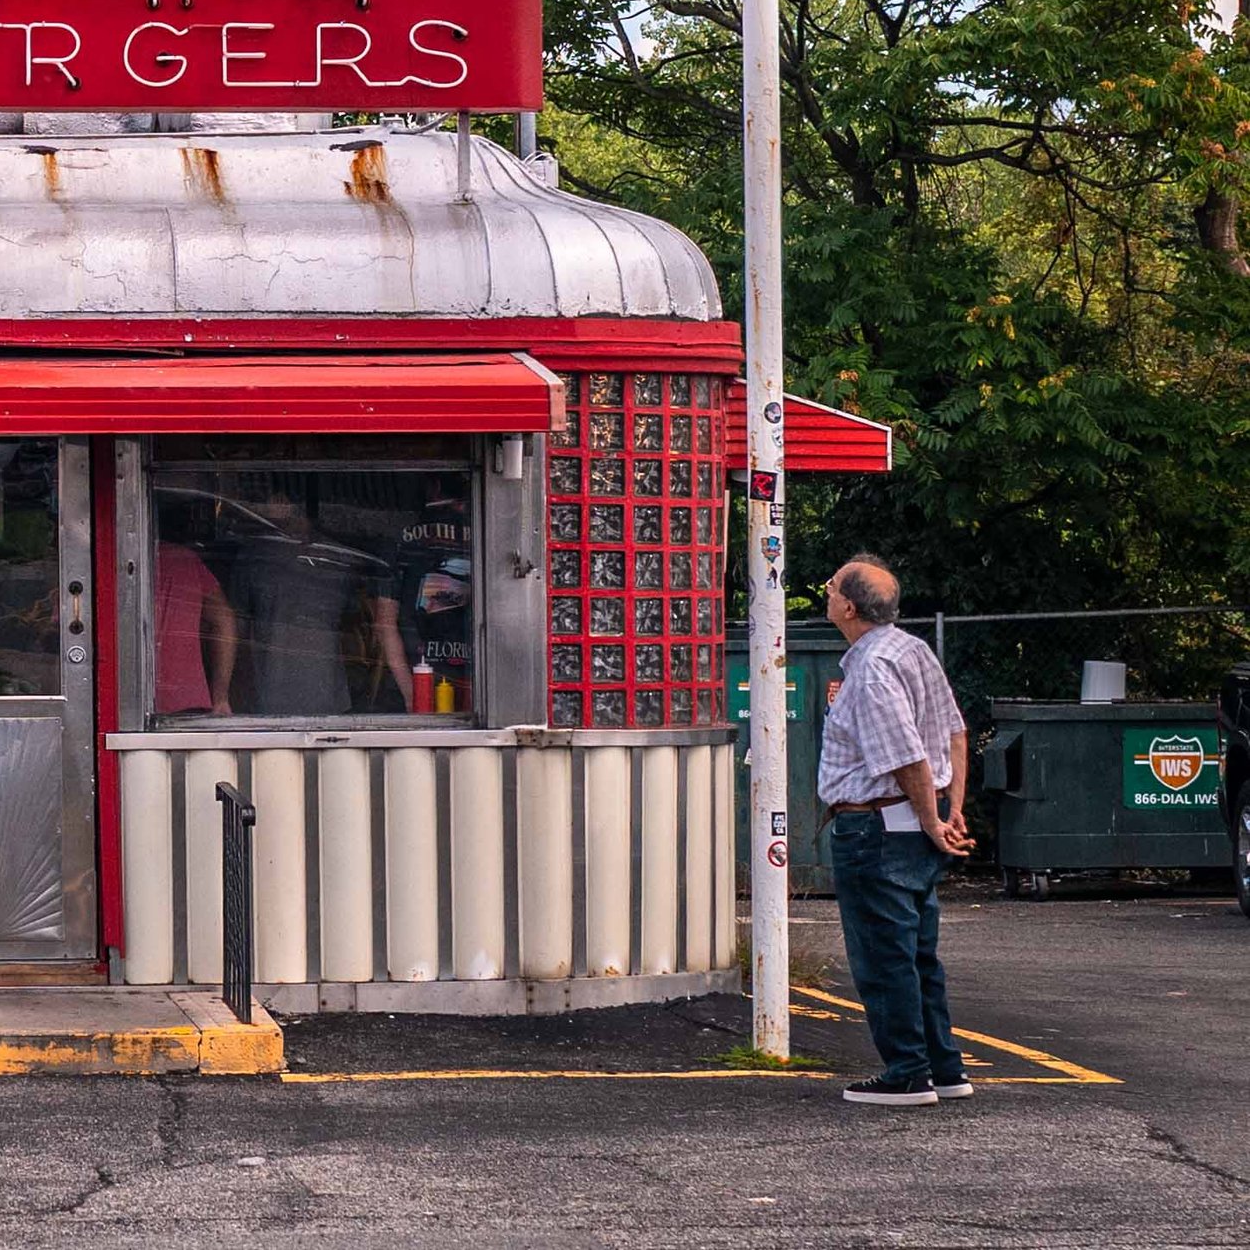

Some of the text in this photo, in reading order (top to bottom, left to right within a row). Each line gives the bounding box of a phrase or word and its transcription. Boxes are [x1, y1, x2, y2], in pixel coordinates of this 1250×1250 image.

[1160, 759, 1192, 777] IWS
[1134, 793, 1218, 805] 866-DIAL IWS
